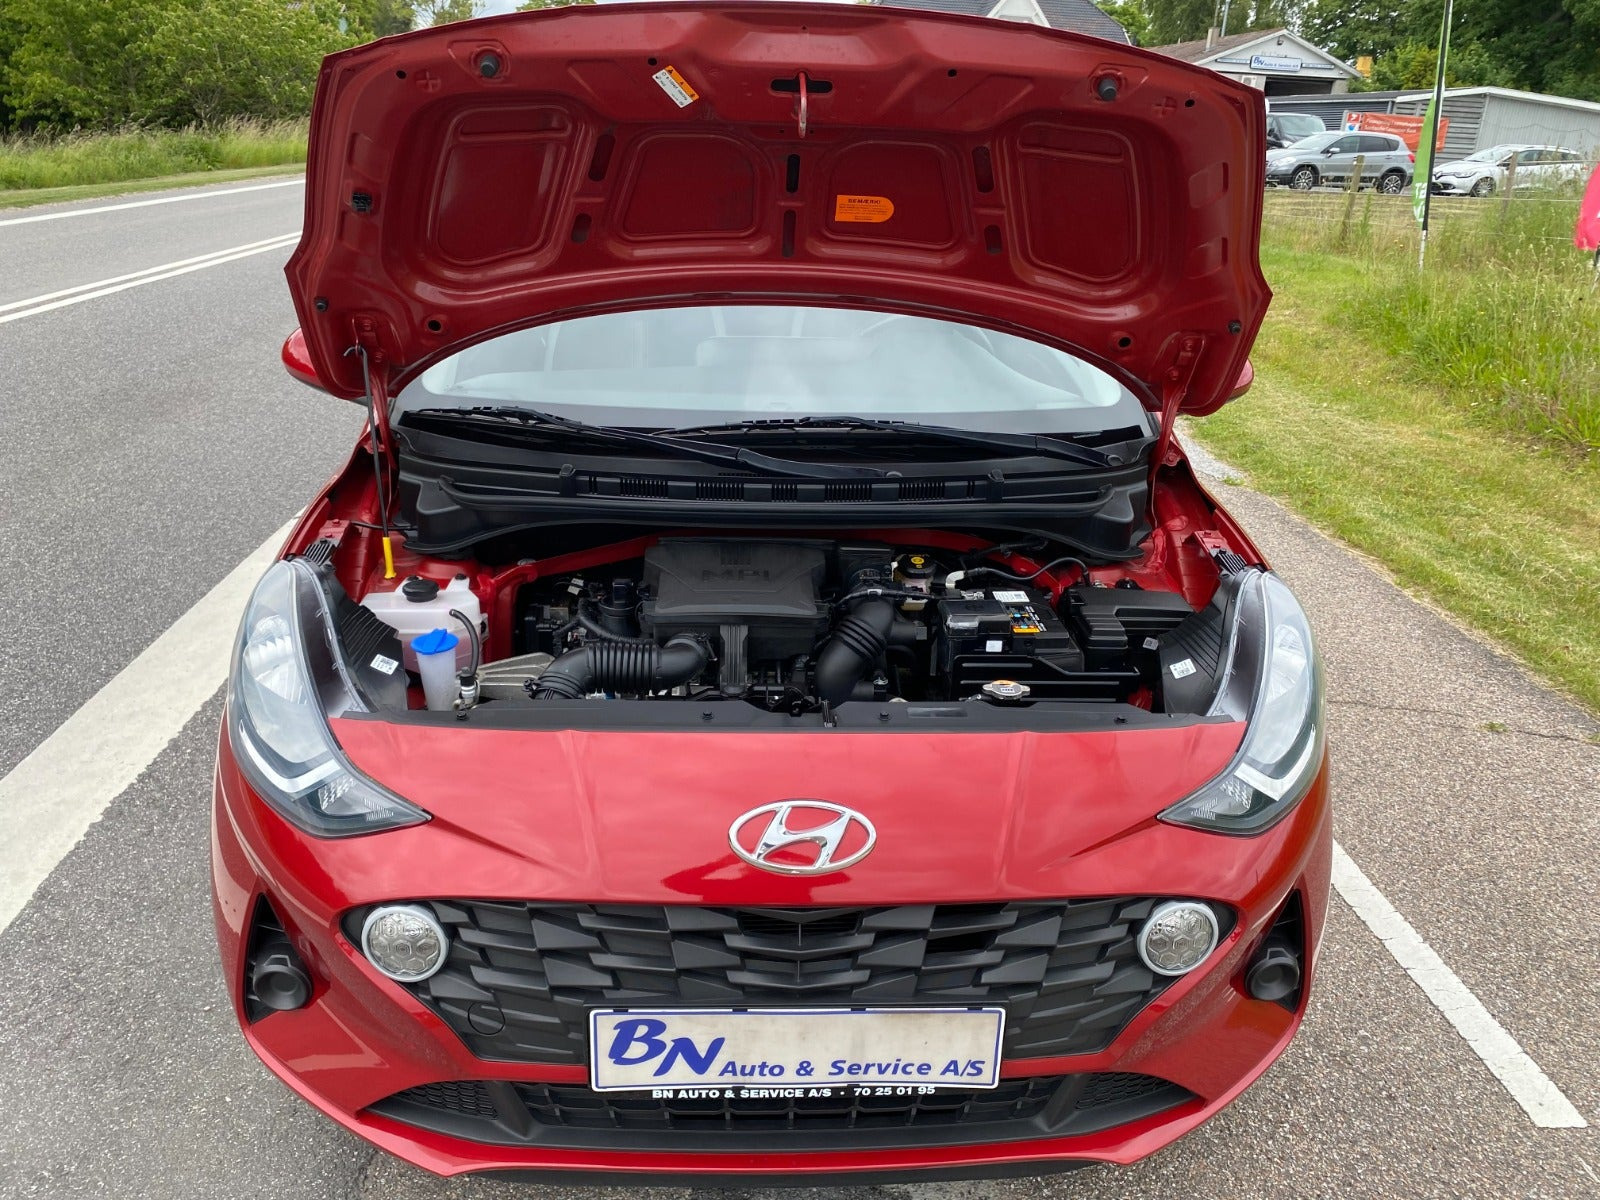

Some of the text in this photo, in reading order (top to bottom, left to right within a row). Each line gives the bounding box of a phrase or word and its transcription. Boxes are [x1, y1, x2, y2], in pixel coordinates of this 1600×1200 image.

[608, 1018, 986, 1077] BN Auto & Service A/S
[652, 1086, 936, 1099] BN AUTO & SERVICE A/S 70 25 01 95
